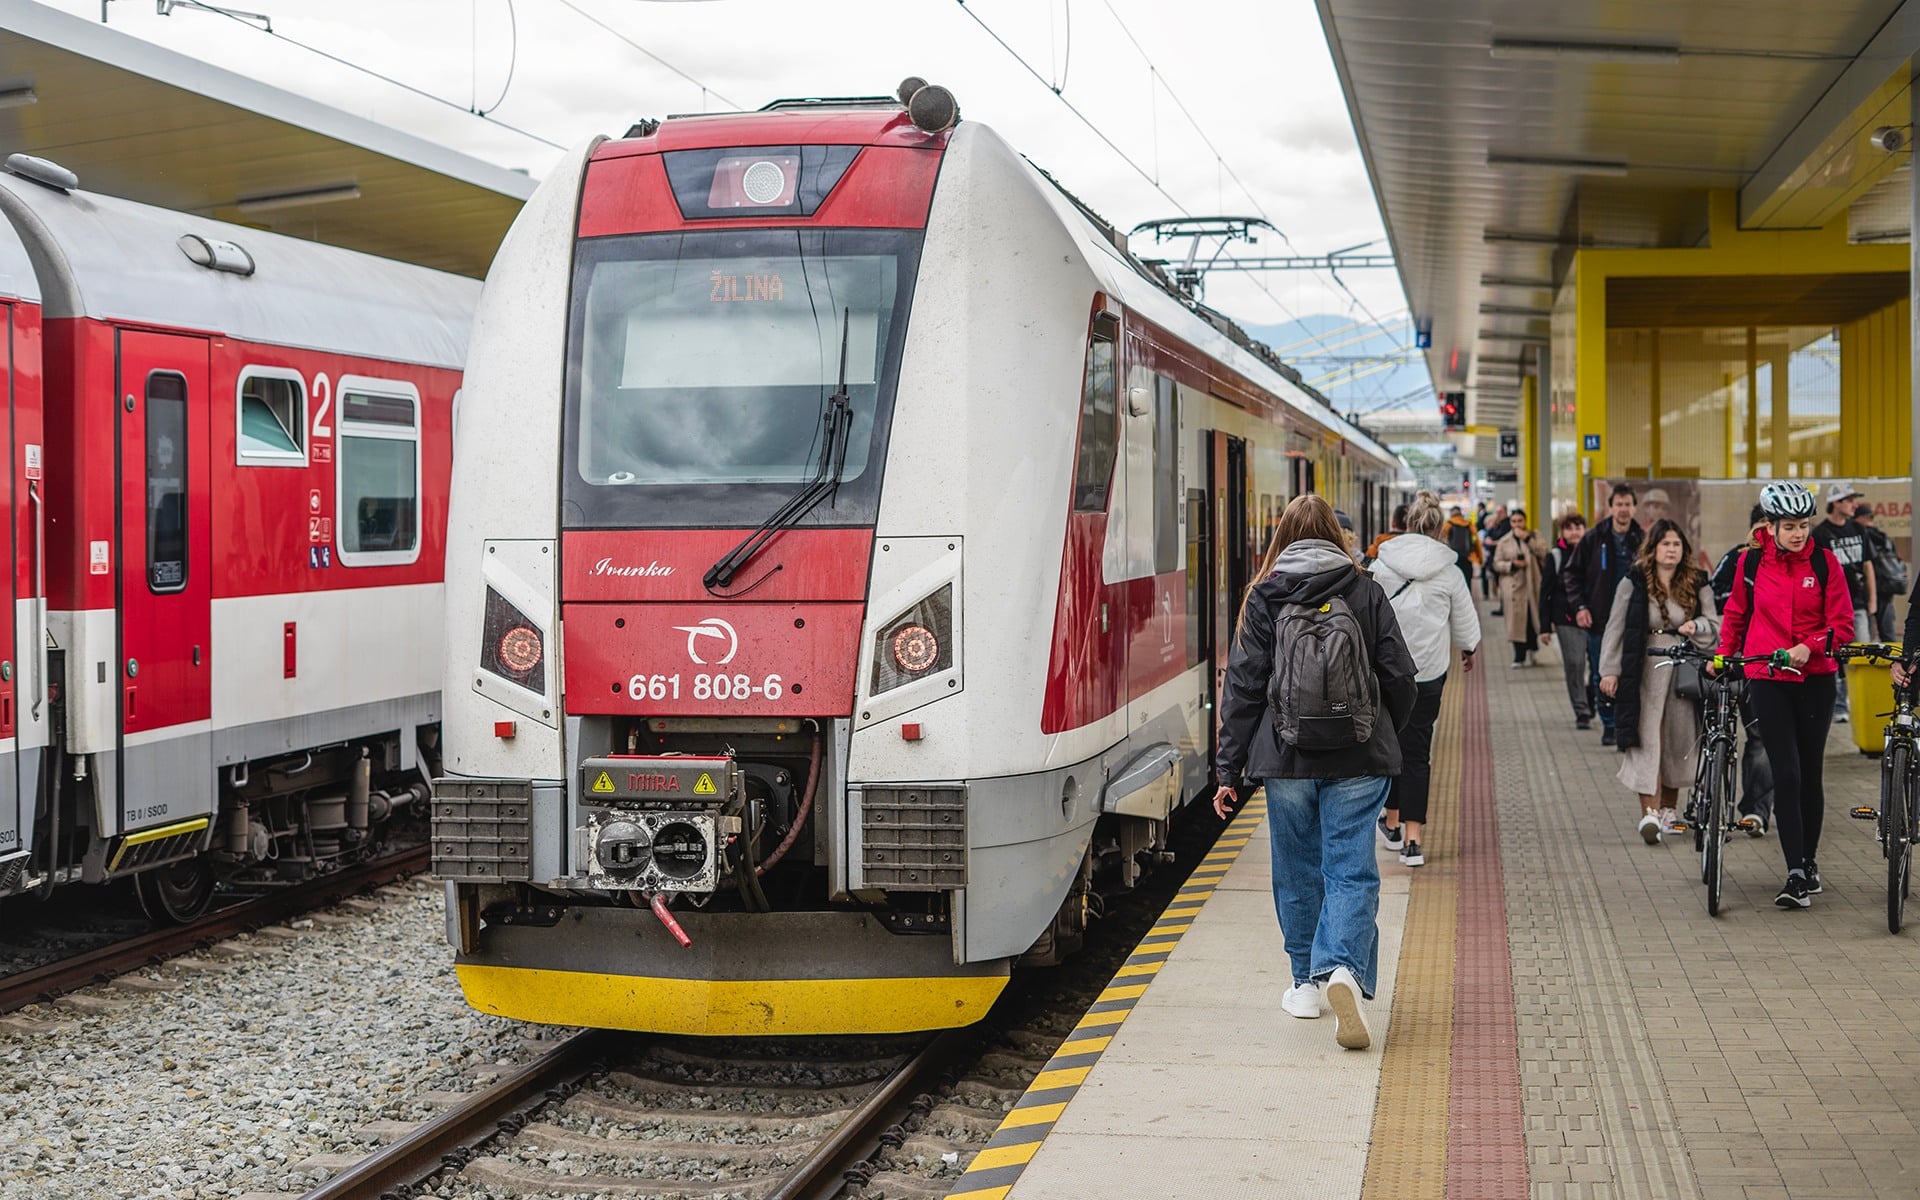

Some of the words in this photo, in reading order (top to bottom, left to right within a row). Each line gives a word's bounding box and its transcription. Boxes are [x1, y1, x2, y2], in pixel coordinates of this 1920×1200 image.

[710, 269, 783, 302] ŽILINA
[312, 371, 331, 437] 2
[628, 673, 680, 700] 661
[693, 673, 783, 700] 808-6
[126, 810, 137, 821] TB
[147, 803, 168, 818] SSOD
